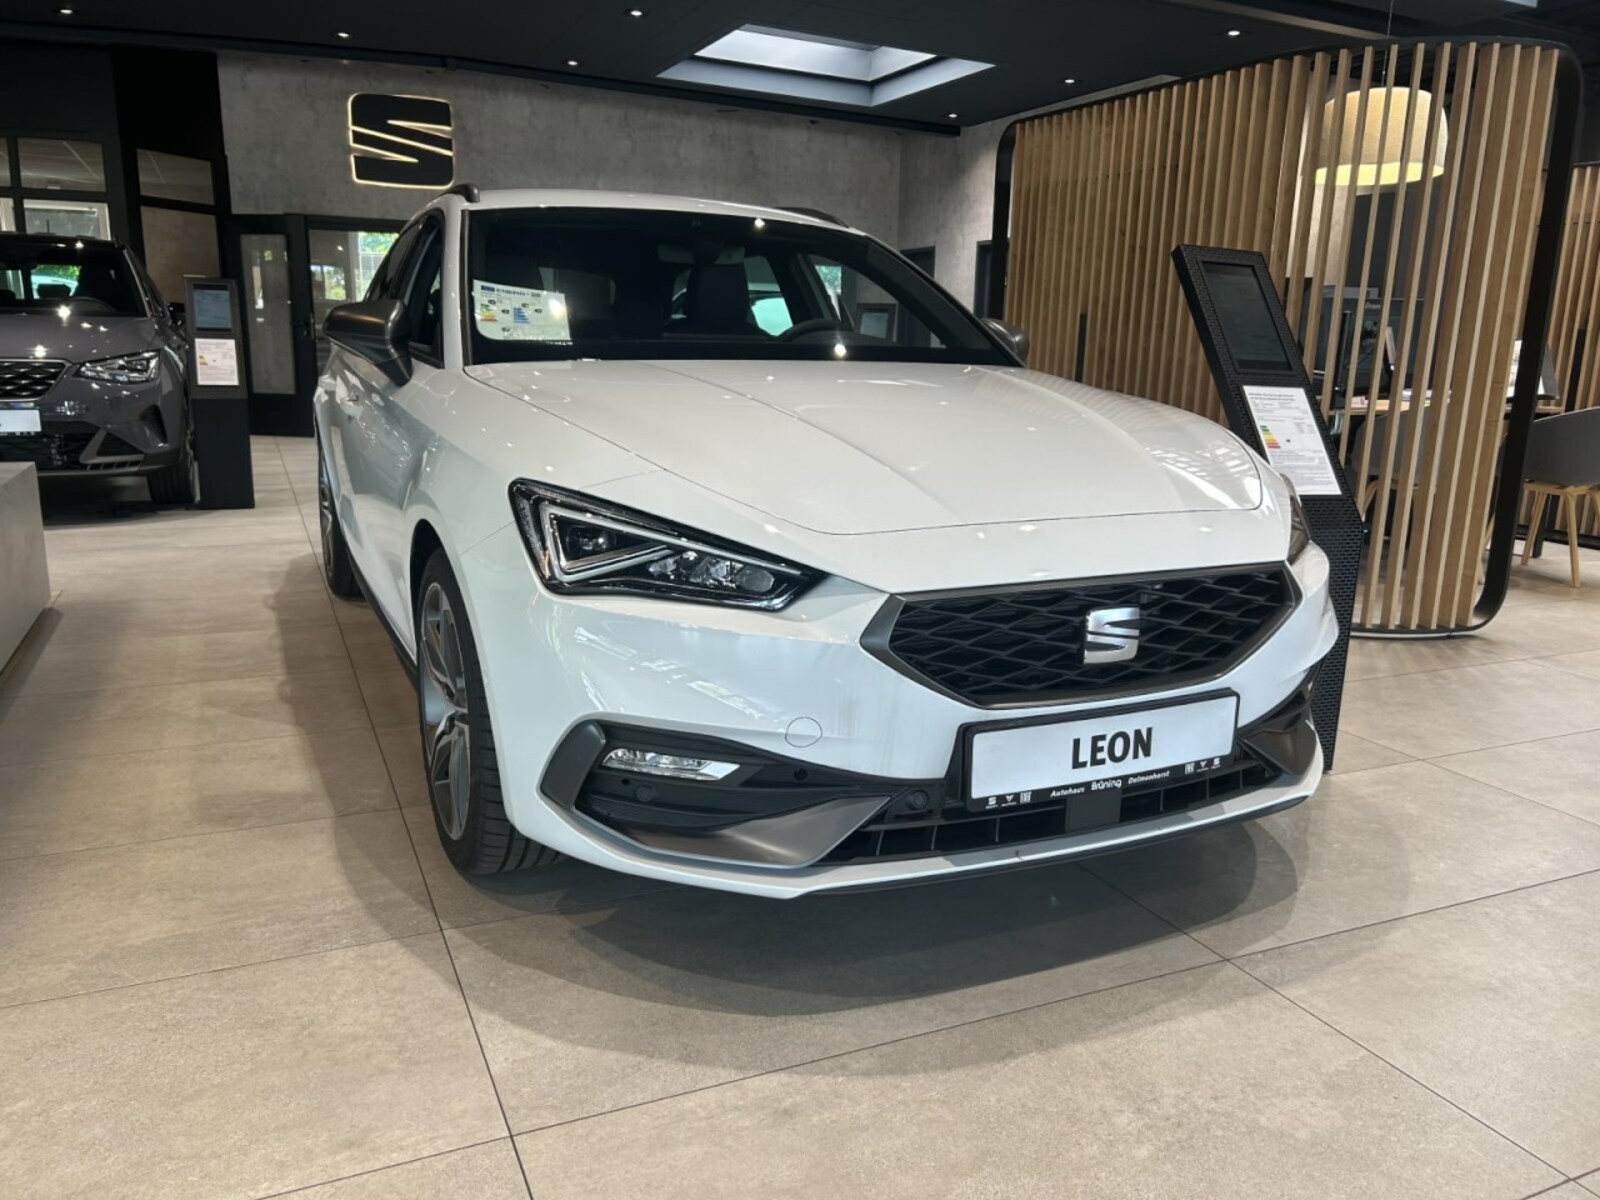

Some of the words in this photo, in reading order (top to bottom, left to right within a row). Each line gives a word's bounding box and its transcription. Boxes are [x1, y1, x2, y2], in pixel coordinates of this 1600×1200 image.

[1071, 727, 1153, 769] LEON
[1050, 786, 1085, 798] Autohaus
[1091, 778, 1122, 791] Brüning
